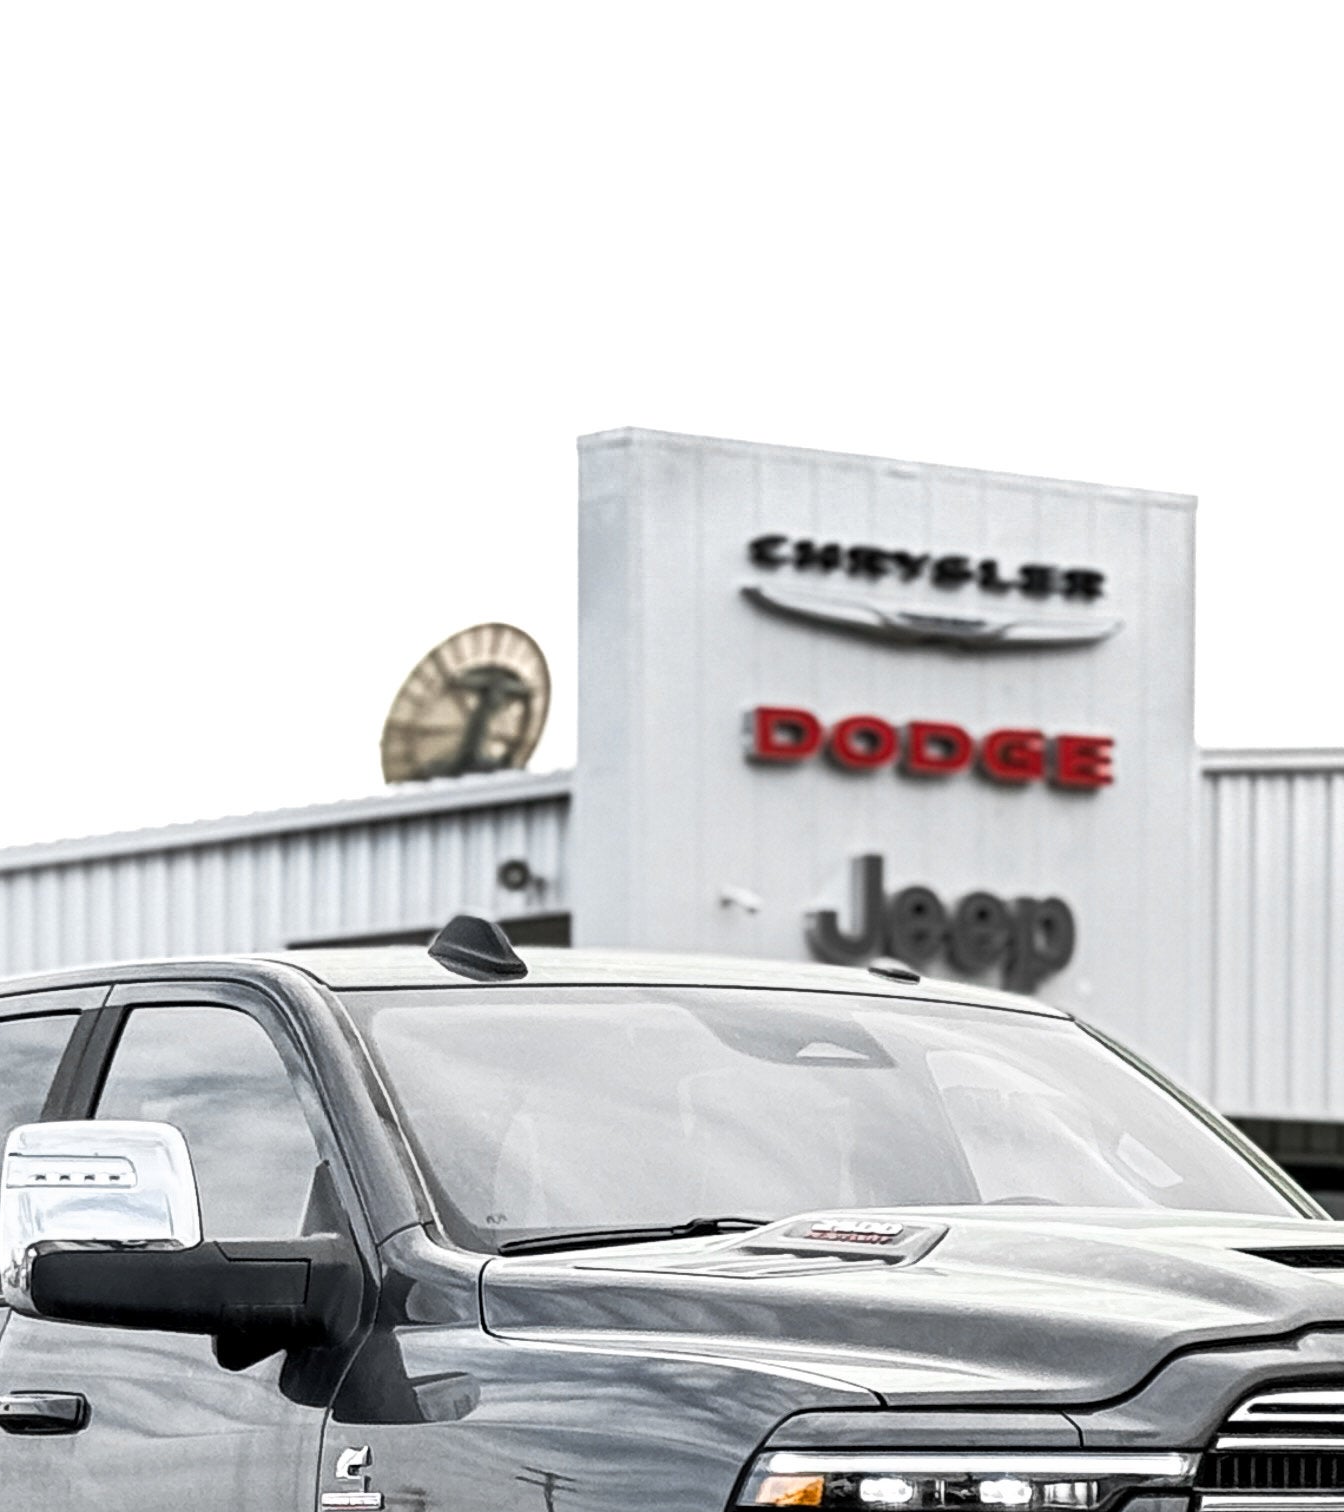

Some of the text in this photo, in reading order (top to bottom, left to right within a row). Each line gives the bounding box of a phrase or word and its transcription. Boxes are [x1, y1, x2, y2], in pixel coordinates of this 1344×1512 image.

[747, 534, 1106, 600] CHRYSLER
[744, 705, 1116, 790] DODGE
[805, 854, 1076, 995] Jeep
